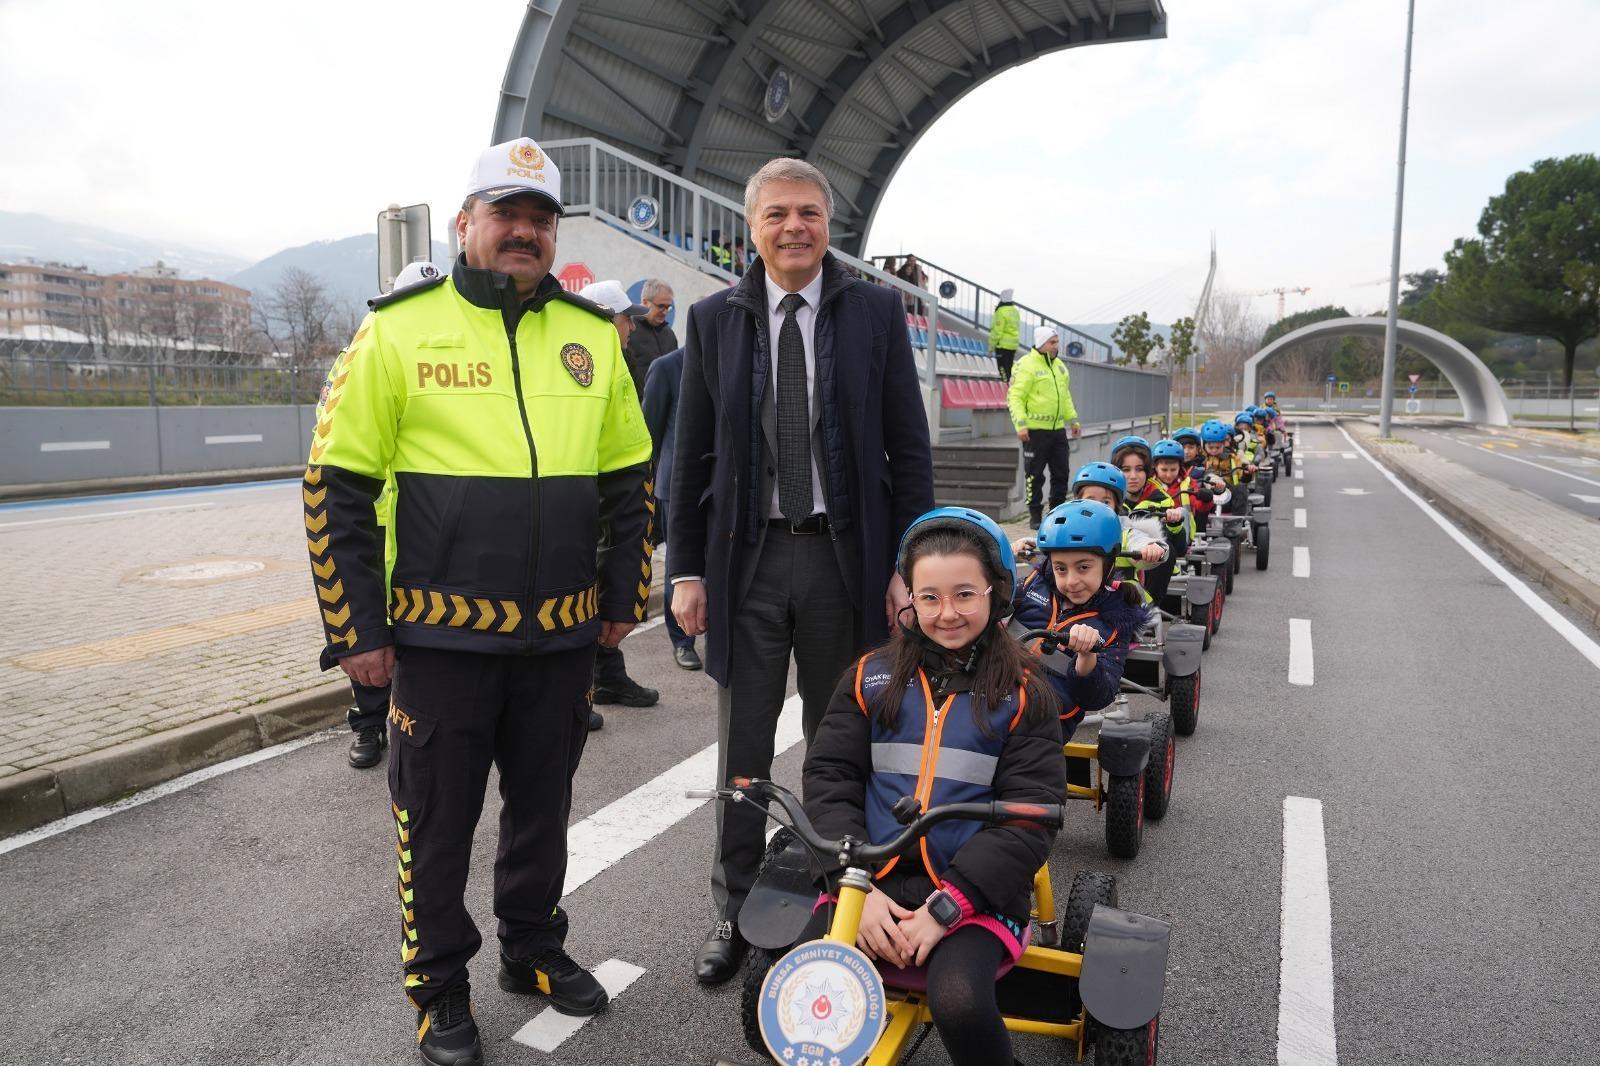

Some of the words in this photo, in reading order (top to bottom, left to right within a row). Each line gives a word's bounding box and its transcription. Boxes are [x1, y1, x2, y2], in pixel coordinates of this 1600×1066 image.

[768, 963, 794, 999] BURSA
[794, 948, 842, 963] EMNİYET
[801, 1044, 825, 1057] EGM
